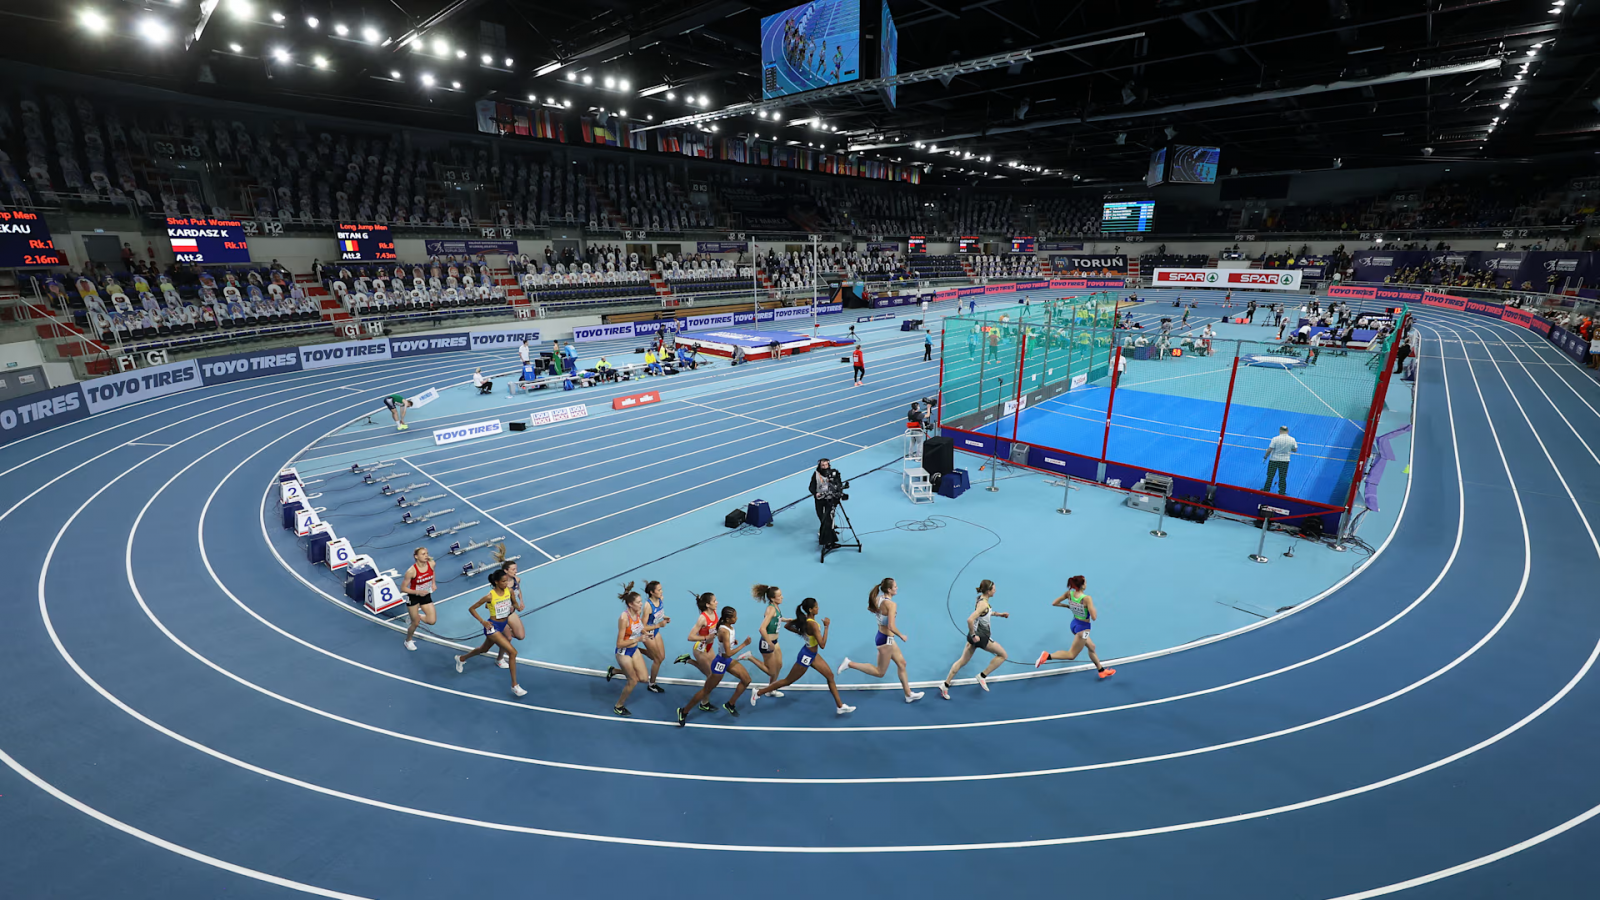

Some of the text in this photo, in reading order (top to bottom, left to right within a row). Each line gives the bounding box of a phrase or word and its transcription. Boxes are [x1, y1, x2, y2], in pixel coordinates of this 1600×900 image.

[181, 144, 201, 157] H3
[13, 211, 37, 220] Men
[190, 218, 207, 226] Put
[208, 219, 241, 227] Women
[264, 222, 284, 234] H2
[167, 229, 220, 237] KARDASZ
[482, 228, 495, 237] H2
[29, 239, 54, 249] Rk.1
[24, 255, 59, 264] 2.16m
[176, 254, 204, 262] Att.2
[1072, 256, 1124, 268] TORUŃ
[1169, 273, 1205, 281] SPAR
[1240, 274, 1278, 283] SPAR
[1377, 290, 1421, 300] TOYO TIRES
[1425, 295, 1464, 307] TOYO TIRES
[1466, 302, 1485, 311] TOYO
[735, 314, 753, 322] TOYO
[775, 308, 810, 318] TOYO TIRES
[1504, 310, 1518, 320] TOYO
[688, 315, 732, 327] TOYO TIRES
[345, 322, 383, 336] G1 H1
[575, 326, 632, 338] TOYO TIRES
[636, 323, 660, 332] TOYO
[473, 332, 540, 345] TOYO TIRES
[392, 337, 467, 352] TOYO TIRES
[304, 344, 386, 361] TOYO TIRES
[118, 350, 169, 371] F1 G1
[203, 353, 297, 377] TOYO TIRES
[88, 367, 194, 403] TOYO TIRES
[18, 392, 80, 423] TIRES
[436, 423, 500, 441] TOYO TIRES
[288, 487, 297, 496] 2
[304, 516, 315, 527] 4
[337, 548, 348, 560] 6
[381, 587, 393, 602] 8
[716, 663, 725, 671] 10
